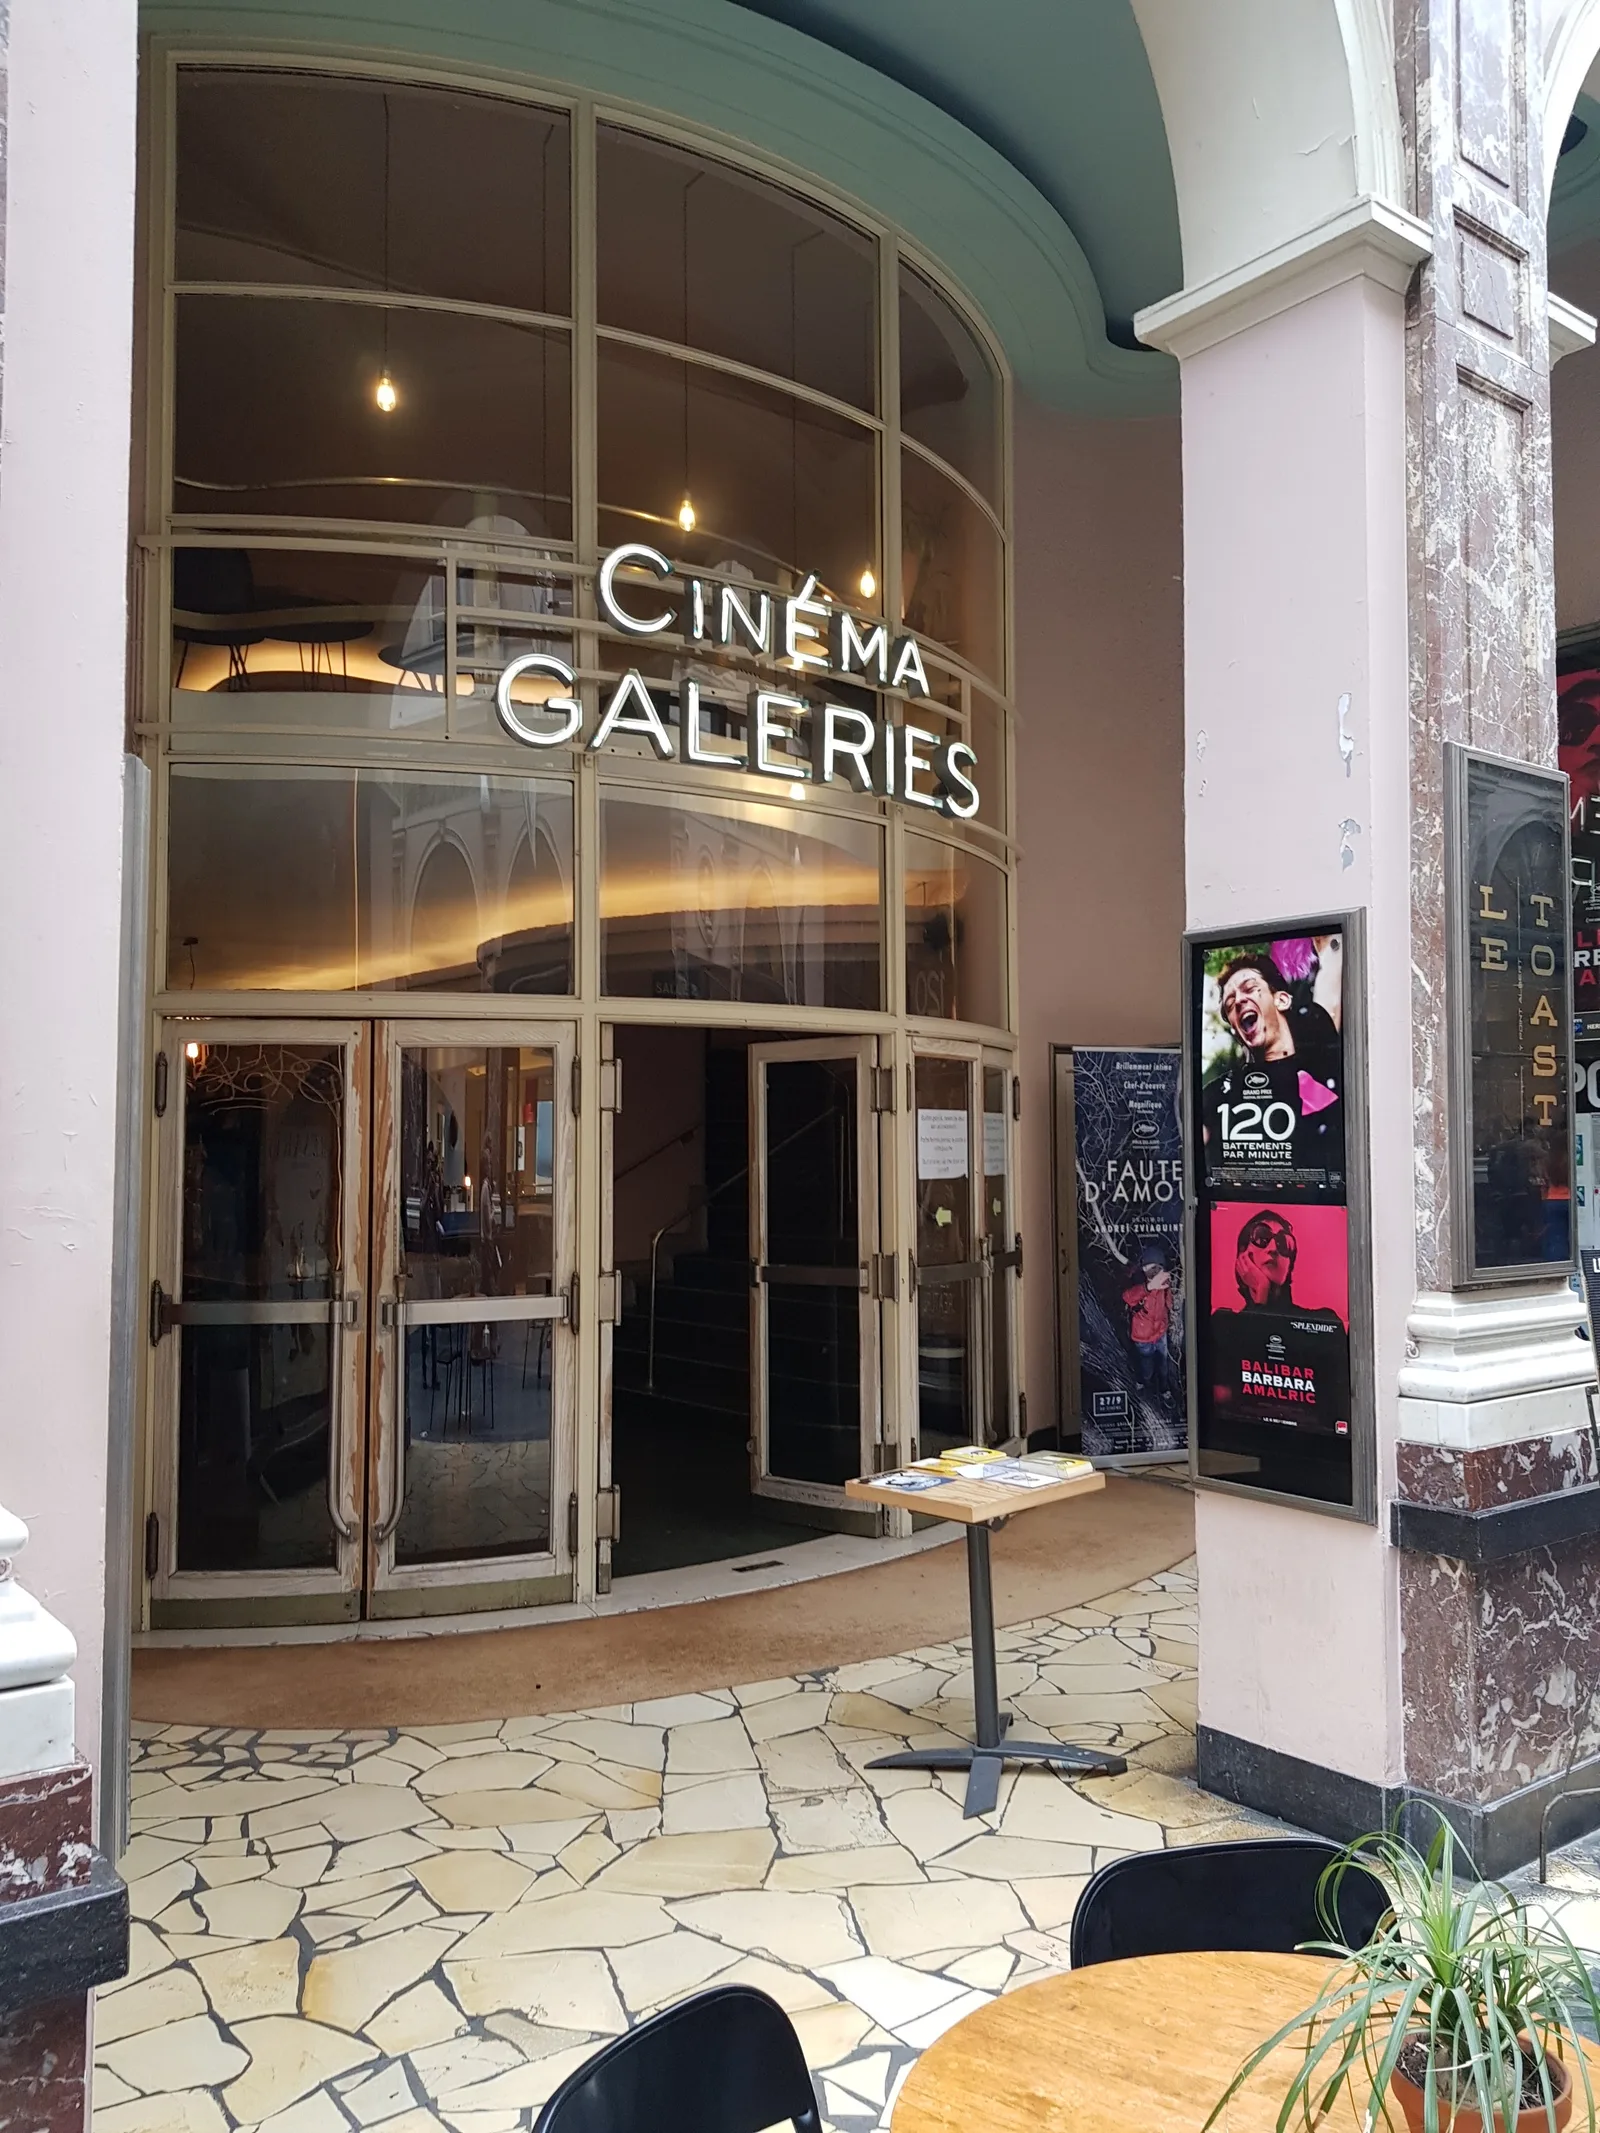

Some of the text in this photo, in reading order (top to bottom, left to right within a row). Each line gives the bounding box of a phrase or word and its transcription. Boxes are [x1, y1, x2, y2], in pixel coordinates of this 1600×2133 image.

[600, 543, 931, 698] CINÉMA
[497, 653, 980, 819] GALERIES
[1480, 885, 1508, 972] LE
[1530, 894, 1558, 1126] TOAST
[1128, 1100, 1162, 1110] Magnifique
[1217, 1102, 1296, 1141] 120
[1222, 1142, 1292, 1150] BATTEMENTS
[1223, 1151, 1292, 1159] PAR MINUTE
[1107, 1160, 1182, 1181] FAUTE
[1133, 1223, 1184, 1232] ZVIAGUINT
[1241, 1359, 1314, 1380] BALIBAR
[1242, 1371, 1315, 1392] BARBARA
[1242, 1384, 1316, 1404] AMALRIC
